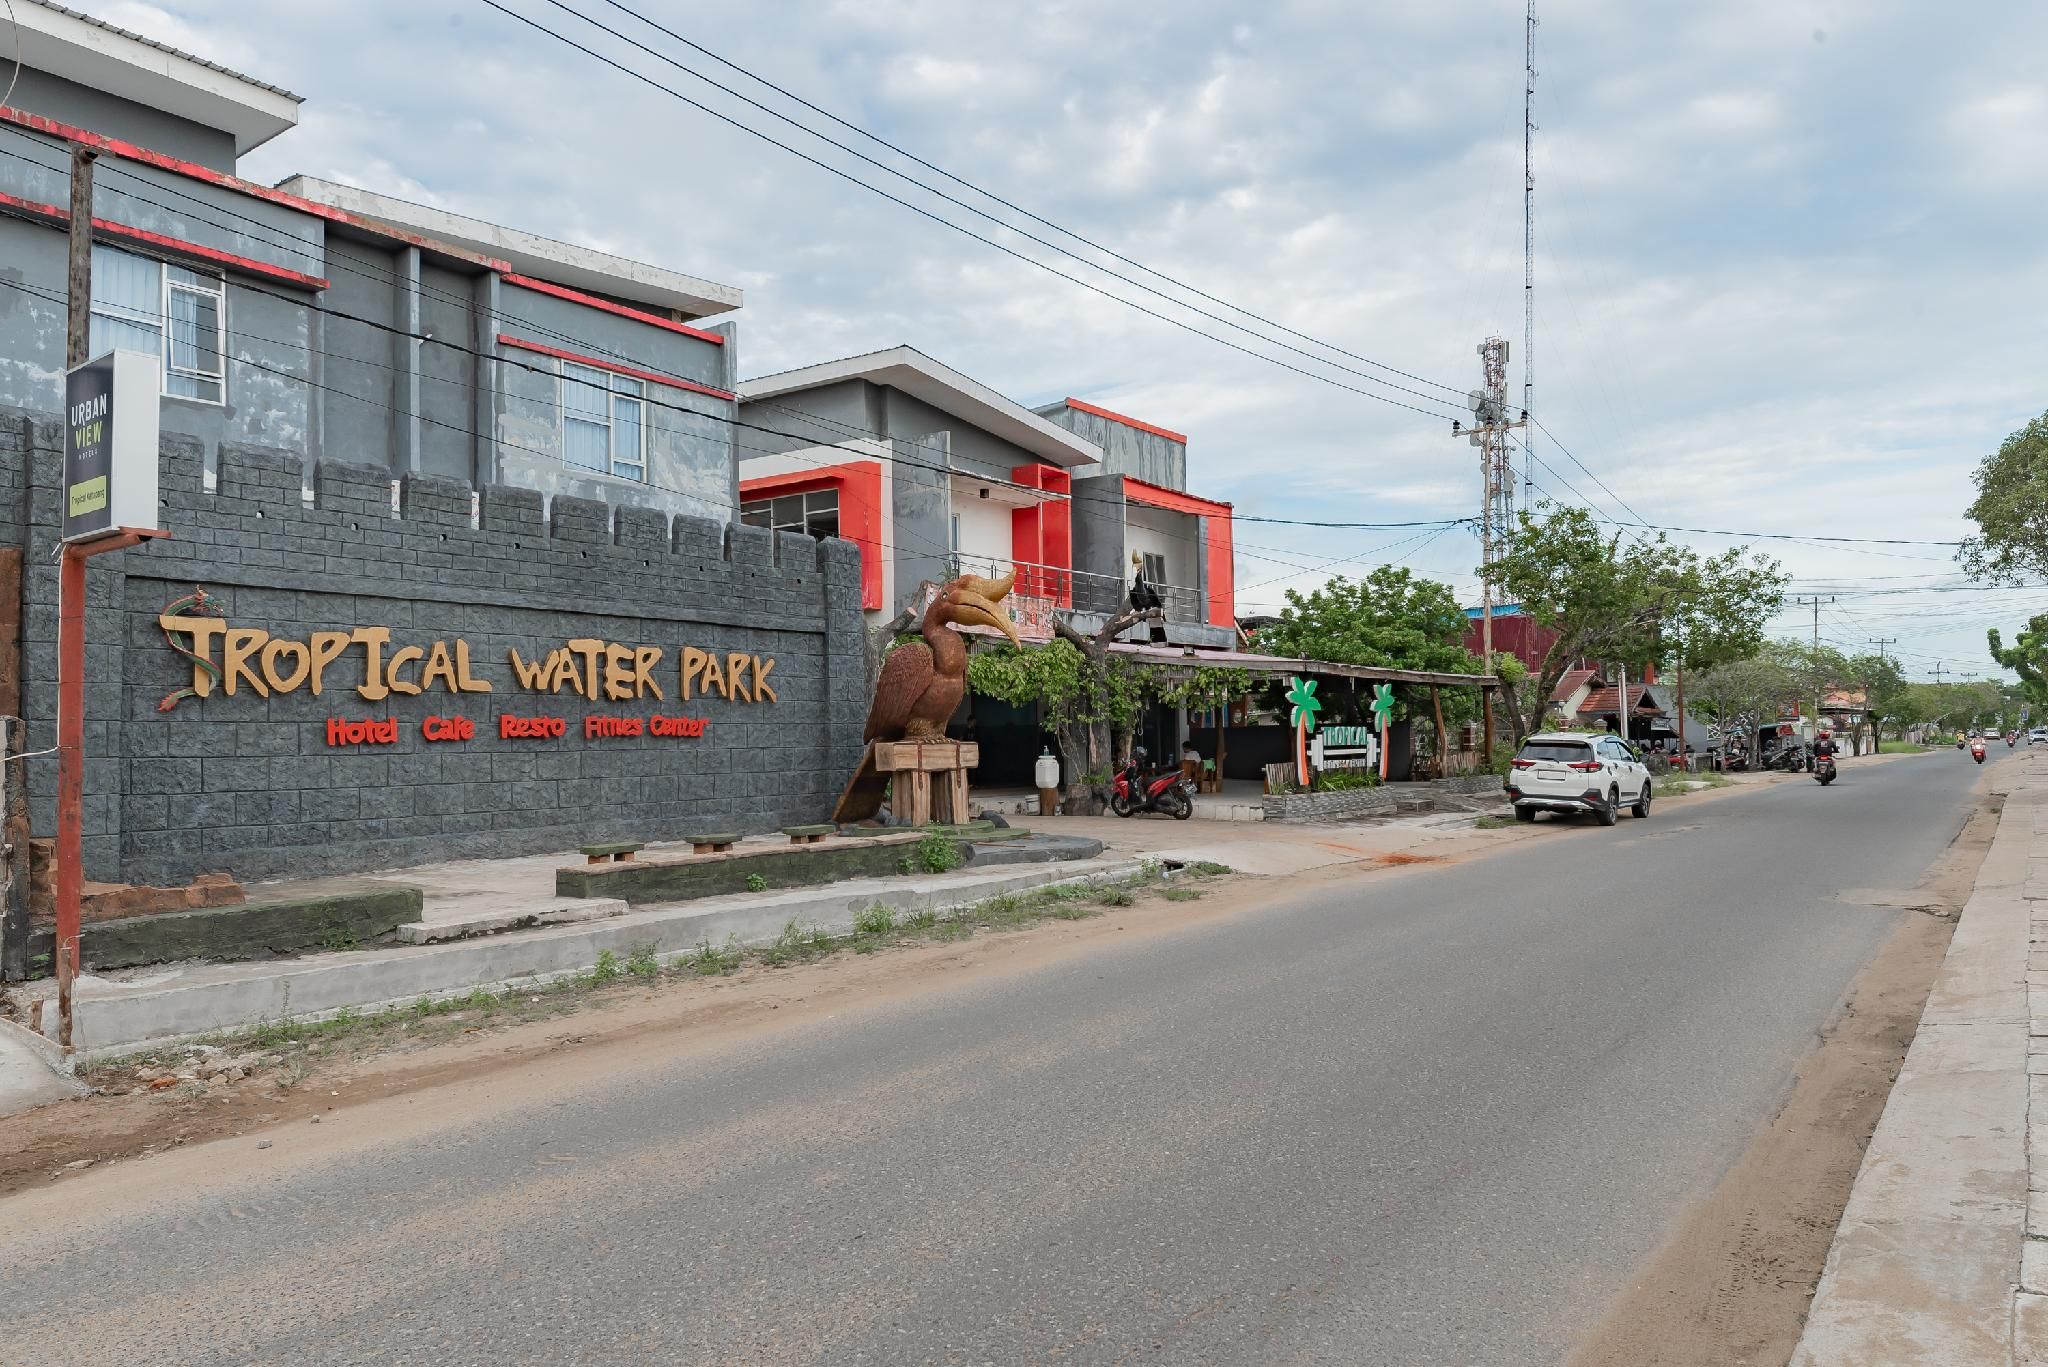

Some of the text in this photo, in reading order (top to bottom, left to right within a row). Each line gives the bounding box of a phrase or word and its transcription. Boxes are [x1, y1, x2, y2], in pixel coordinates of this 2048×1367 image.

[71, 393, 107, 427] URBAN
[75, 420, 103, 450] VIEW
[158, 614, 778, 704] TROPICAL WATER PARK
[326, 716, 399, 746] Hotel
[422, 715, 475, 741] Cafe
[500, 714, 566, 739] Resto
[649, 714, 710, 738] Center
[1321, 726, 1368, 746] TROPICAL
